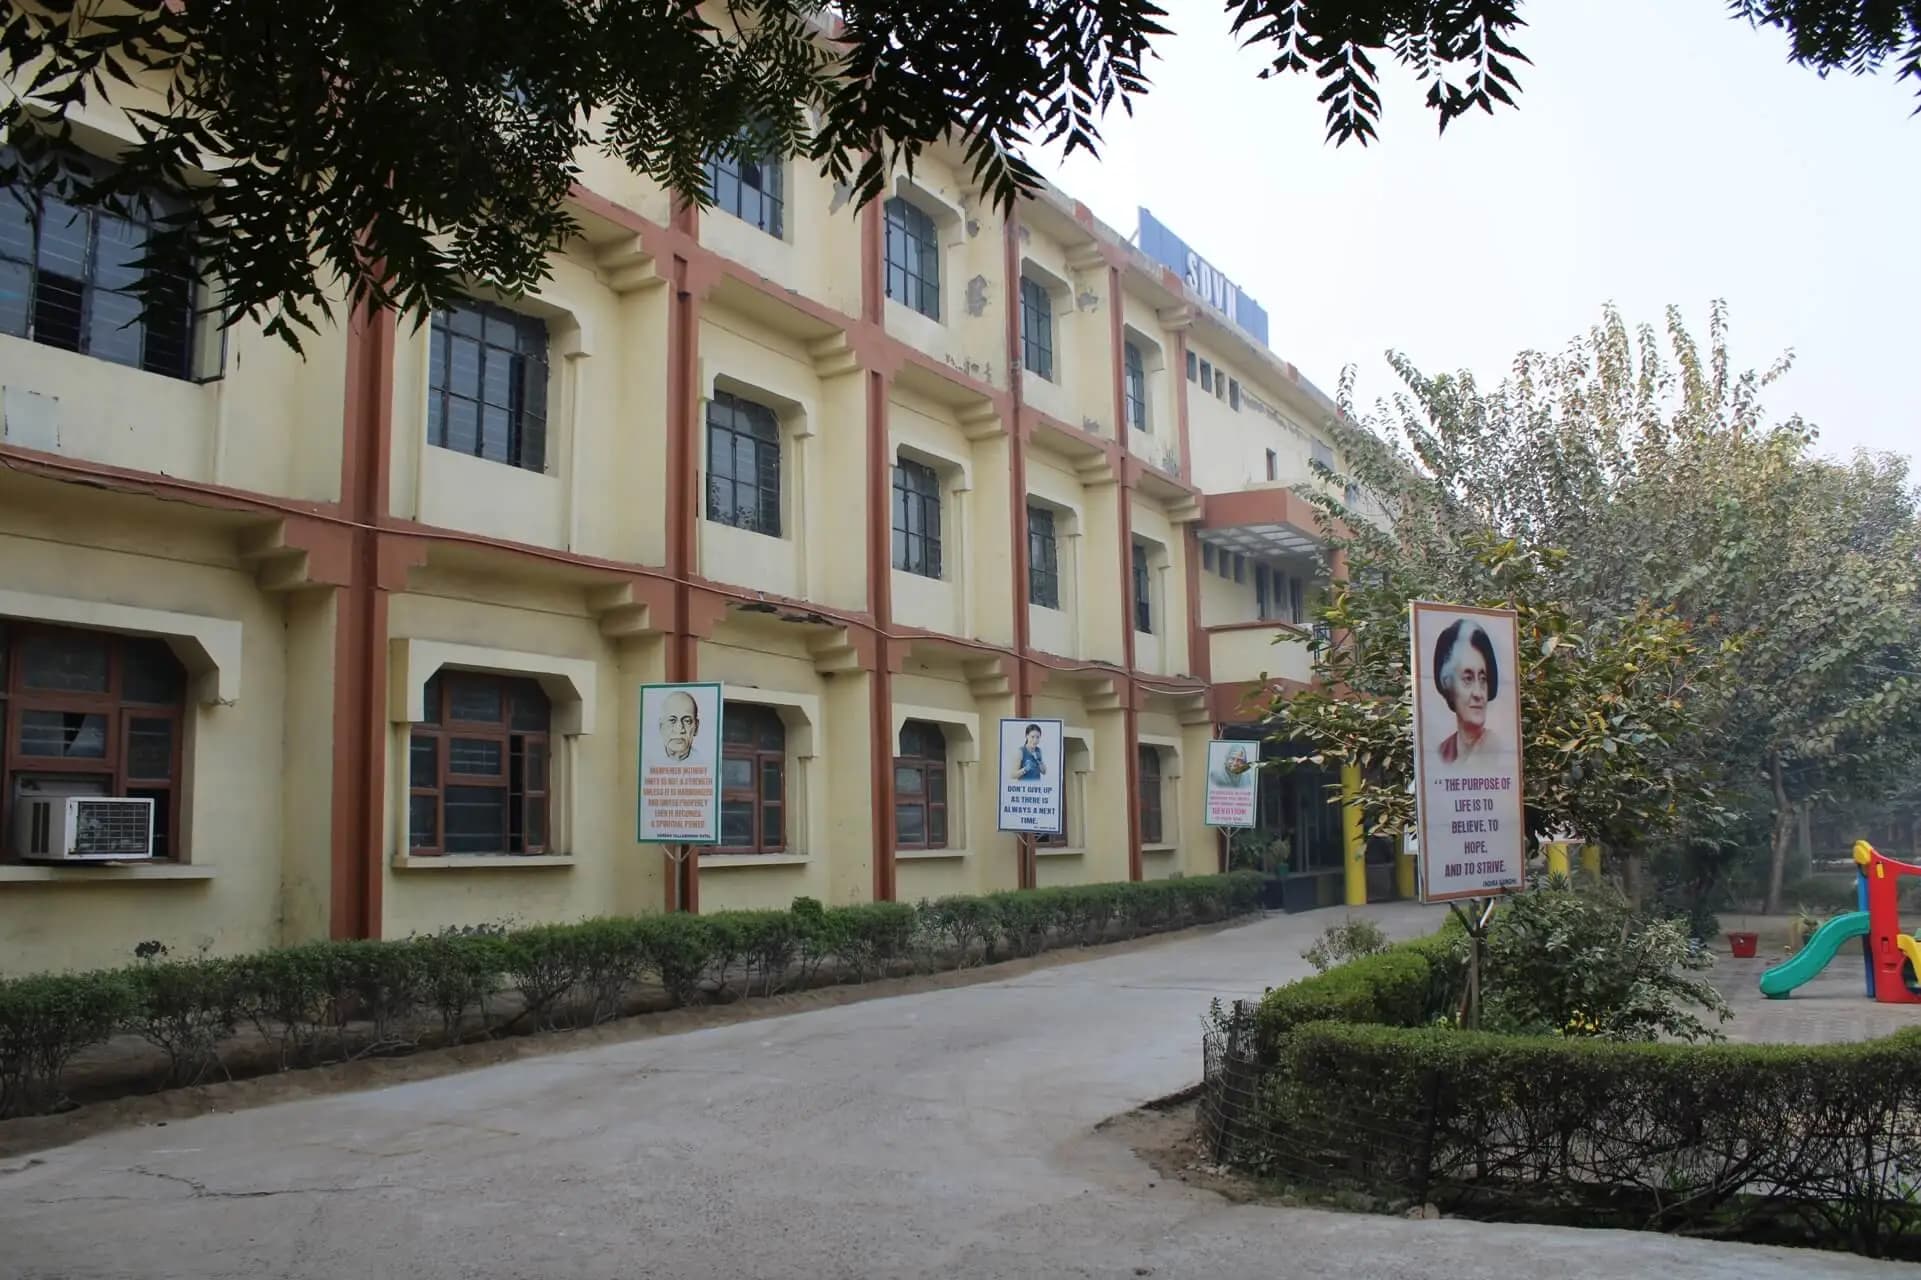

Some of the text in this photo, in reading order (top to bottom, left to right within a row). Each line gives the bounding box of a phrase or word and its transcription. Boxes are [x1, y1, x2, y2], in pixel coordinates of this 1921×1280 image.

[1043, 786, 1053, 794] UP
[1445, 778, 1461, 791] THE
[1462, 777, 1500, 791] PURPOSE
[1501, 777, 1511, 790] OF
[1004, 805, 1032, 813] ALWAYS
[1455, 798, 1493, 812] LIFE IS TO
[1488, 819, 1499, 832] TO
[1445, 863, 1462, 877] AND
[1464, 862, 1475, 876] TO
